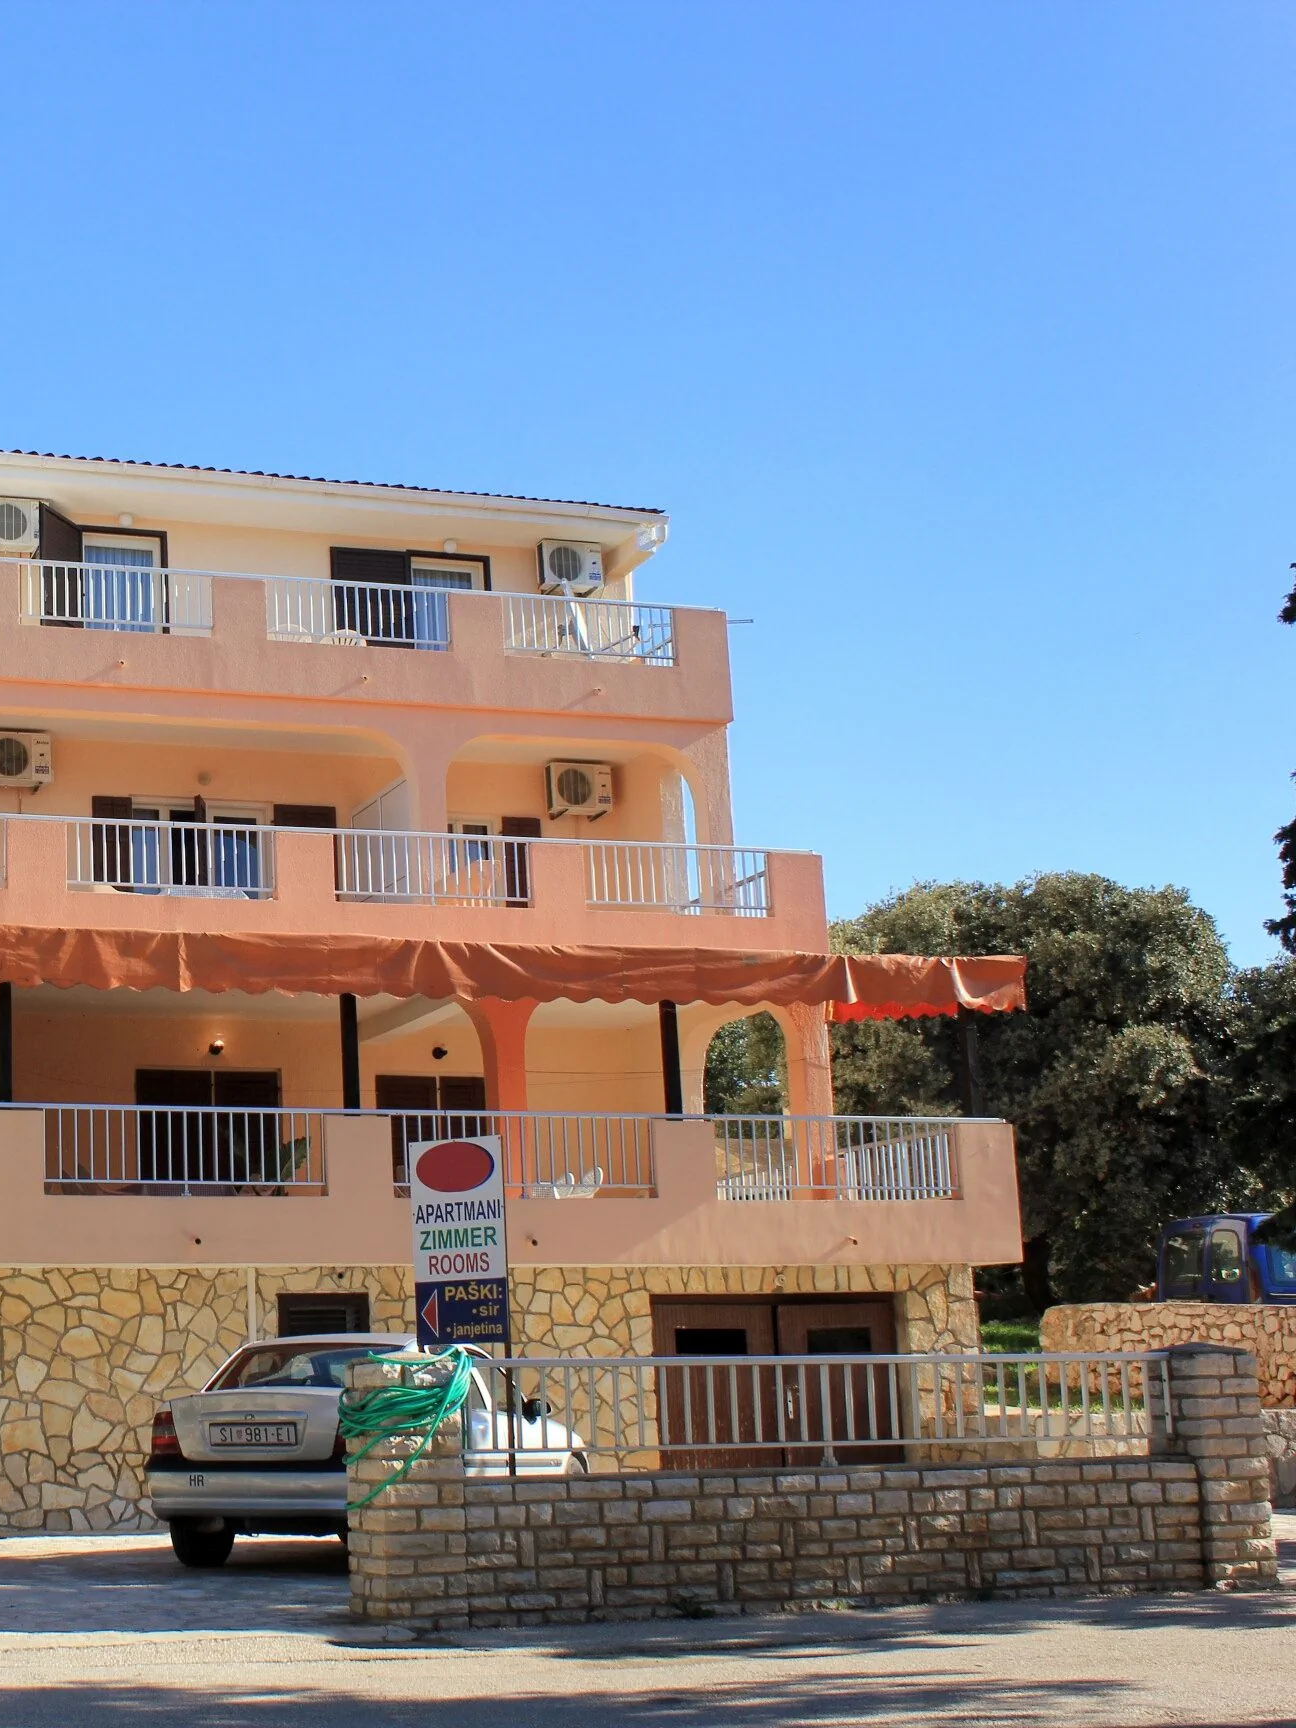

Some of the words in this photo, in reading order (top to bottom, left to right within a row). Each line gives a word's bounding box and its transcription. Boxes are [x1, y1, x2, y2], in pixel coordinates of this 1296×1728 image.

[415, 1198, 501, 1225] APARTMANI
[419, 1226, 498, 1251] ZIMMER
[428, 1252, 490, 1275] ROOMS
[444, 1281, 503, 1301] PAŠKI:
[479, 1301, 500, 1317] sir
[452, 1322, 503, 1339] janjetina
[189, 1474, 204, 1487] HR
